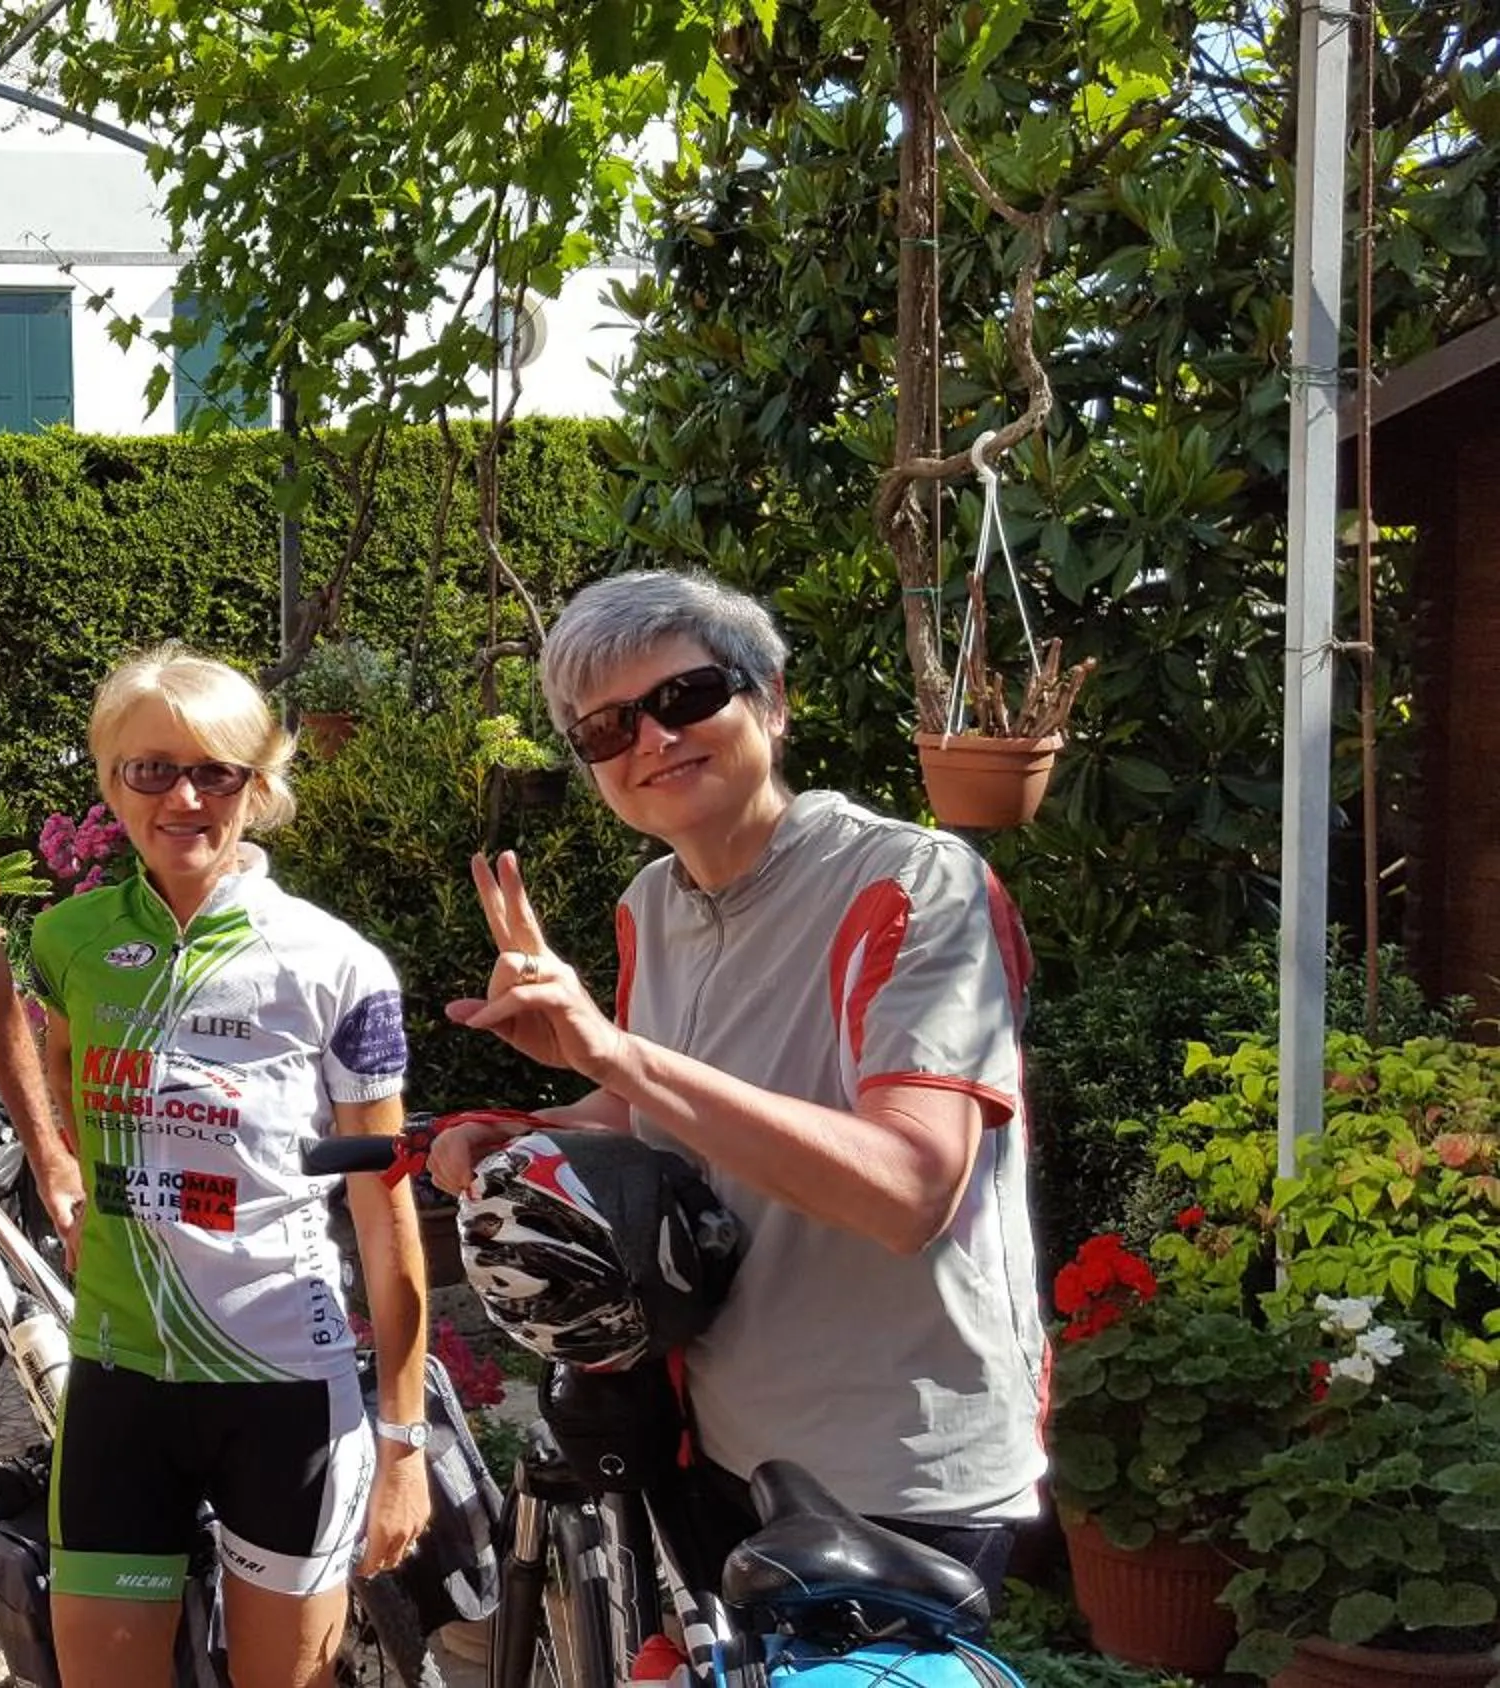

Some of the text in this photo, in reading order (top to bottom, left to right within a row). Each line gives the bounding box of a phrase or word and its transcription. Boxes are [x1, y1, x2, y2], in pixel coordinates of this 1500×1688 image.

[190, 1014, 252, 1041] LIFE
[82, 1047, 153, 1089] KIKI
[84, 1115, 238, 1148] REGGIOLO
